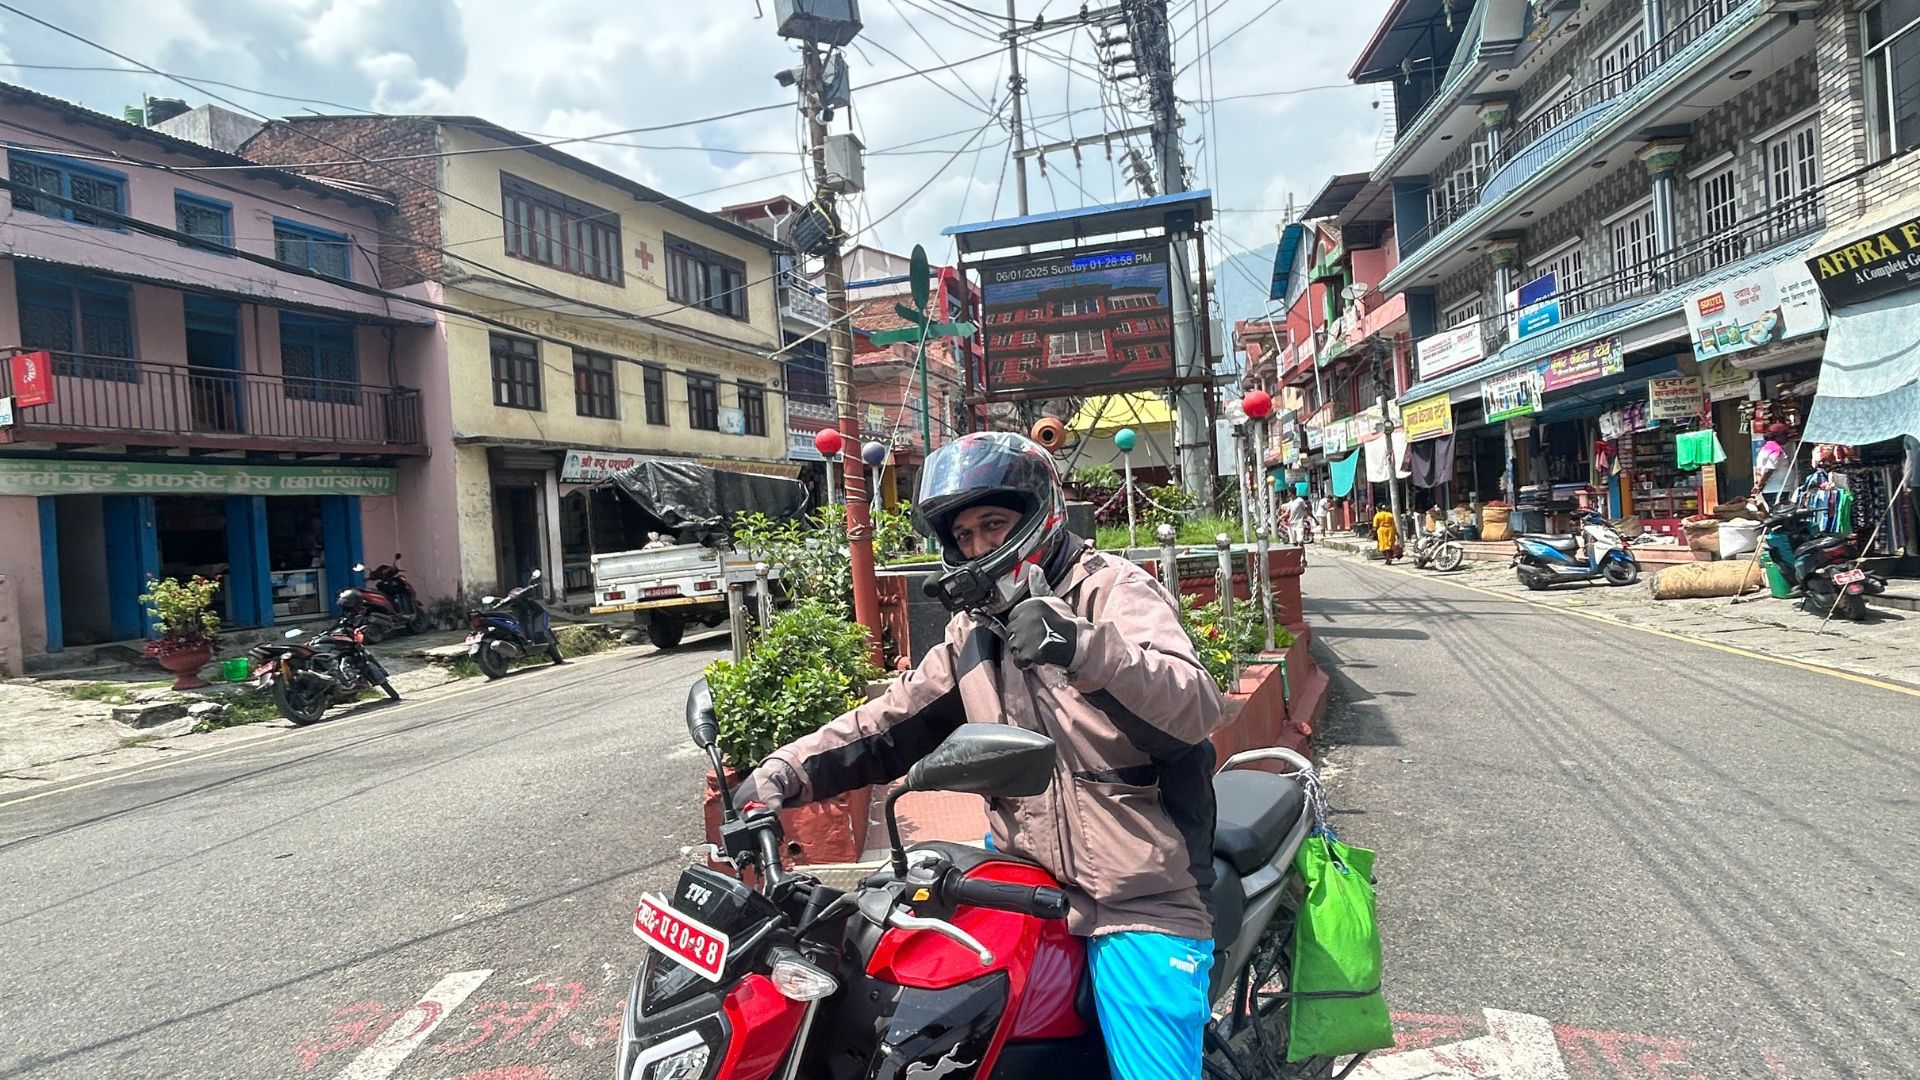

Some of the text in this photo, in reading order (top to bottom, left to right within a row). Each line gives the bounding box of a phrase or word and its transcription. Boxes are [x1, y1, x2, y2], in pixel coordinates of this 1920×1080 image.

[996, 266, 1049, 282] 06/01/2025
[1051, 261, 1088, 276] Sunday
[1135, 253, 1152, 264] PM
[1818, 233, 1901, 280] AFFRA
[1855, 272, 1865, 285] A
[1863, 259, 1909, 281] Complete
[232, 471, 273, 489] प्रेस
[684, 882, 712, 906] TVS
